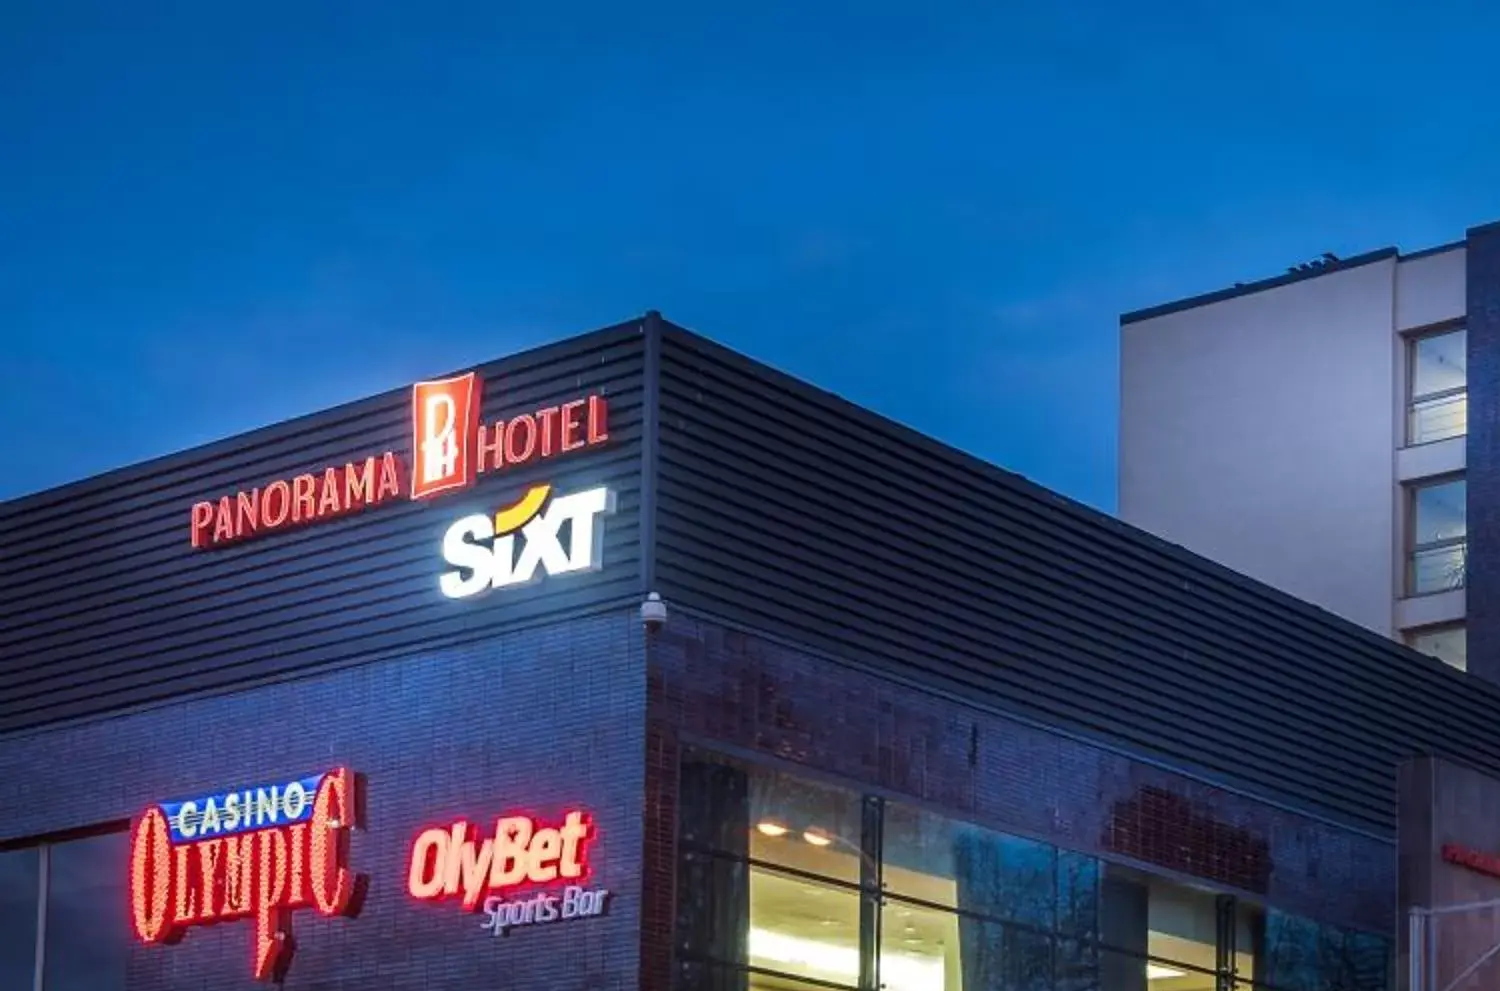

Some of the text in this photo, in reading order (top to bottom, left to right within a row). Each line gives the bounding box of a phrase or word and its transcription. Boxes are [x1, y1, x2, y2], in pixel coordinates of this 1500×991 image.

[191, 451, 400, 547] PANORAMA
[478, 395, 609, 473] HOTEL
[177, 781, 306, 838] CASINO
[409, 810, 591, 905] OlyBet
[480, 885, 609, 937] Sports Bar
